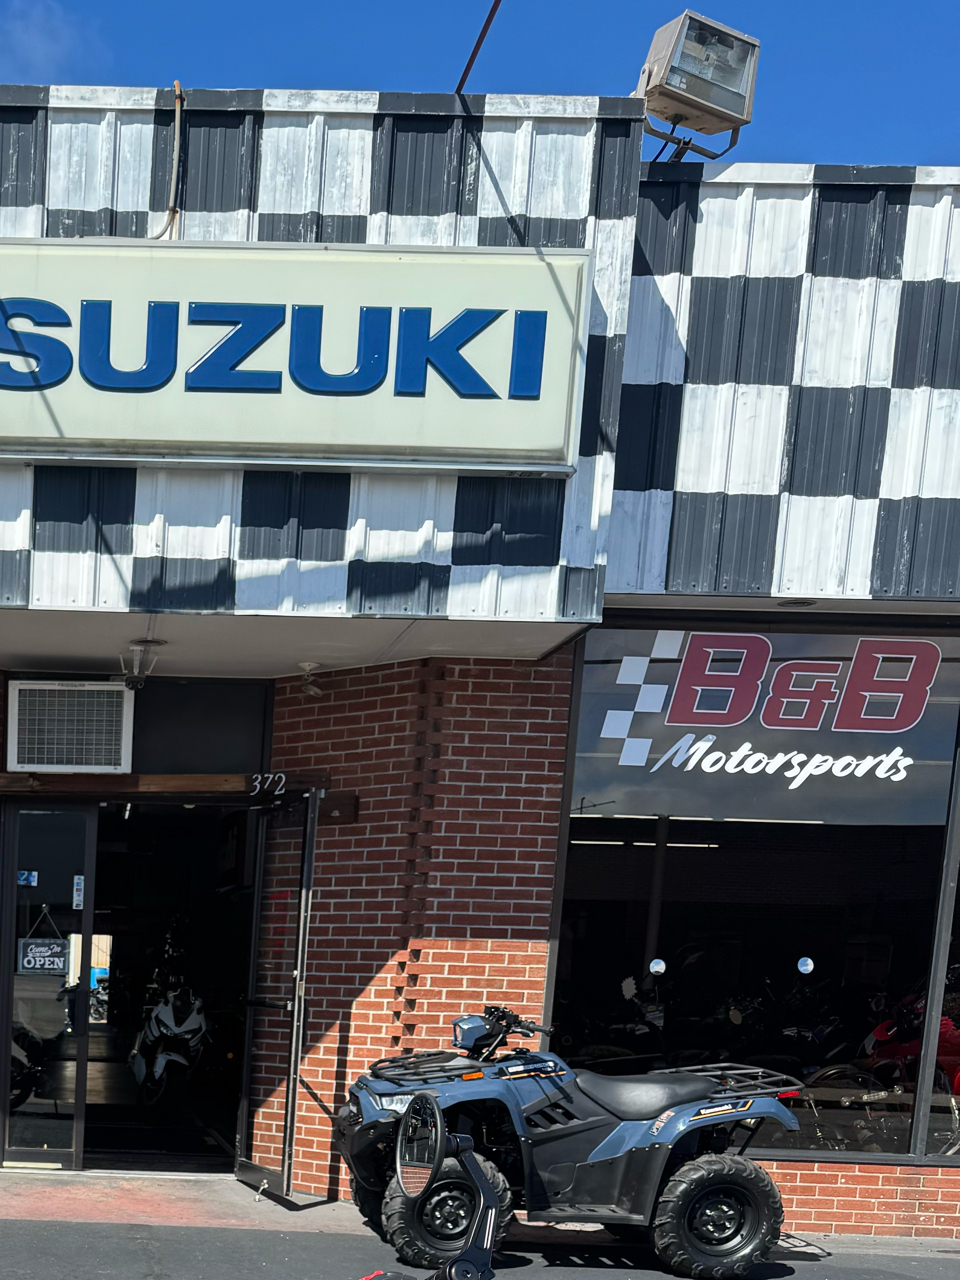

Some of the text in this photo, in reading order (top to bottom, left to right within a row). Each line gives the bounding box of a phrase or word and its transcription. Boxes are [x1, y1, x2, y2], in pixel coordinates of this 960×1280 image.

[664, 631, 942, 734] B&B
[649, 732, 915, 791] Motorsports
[249, 773, 286, 796] 372
[27, 944, 49, 954] Come
[23, 957, 65, 969] OPEN
[700, 1104, 733, 1115] Kawasaki
